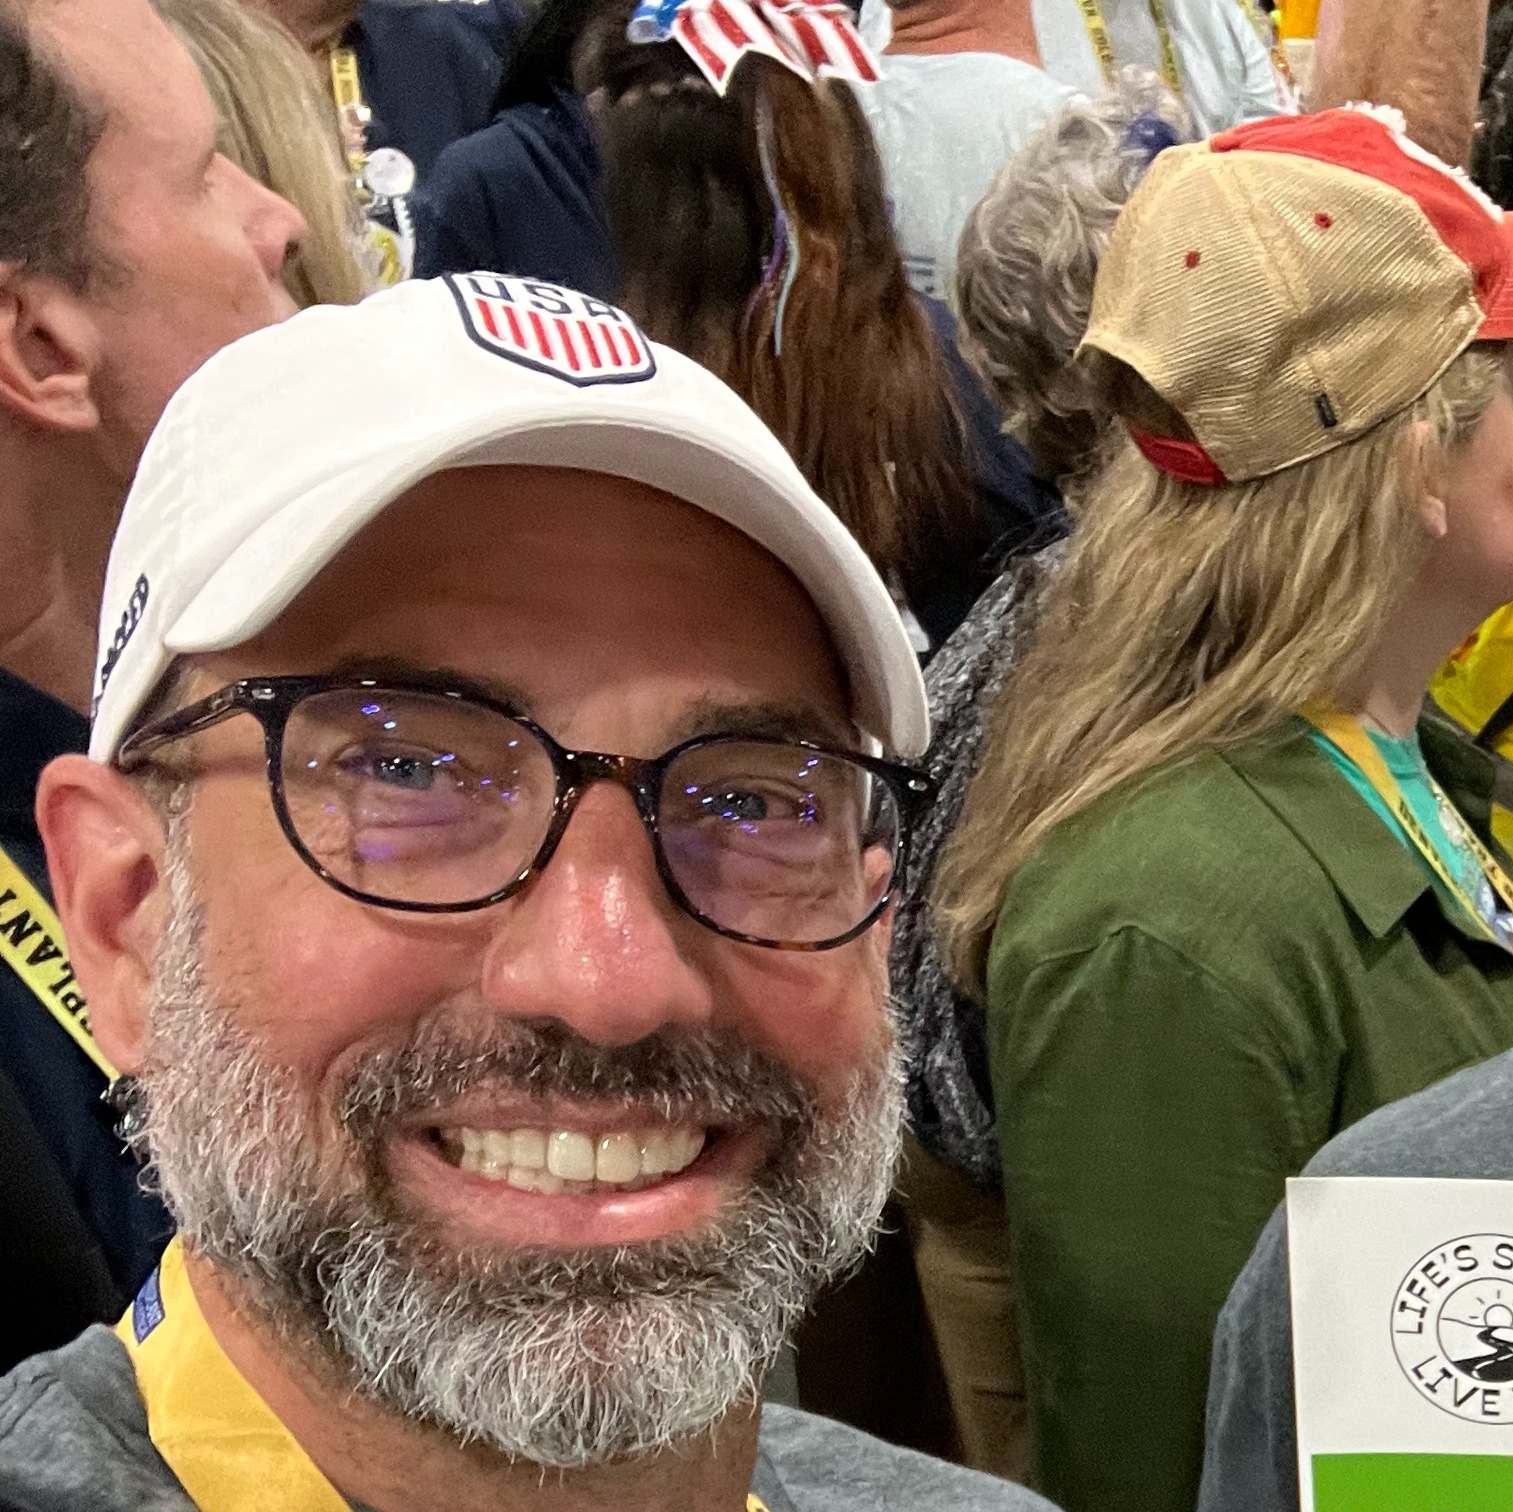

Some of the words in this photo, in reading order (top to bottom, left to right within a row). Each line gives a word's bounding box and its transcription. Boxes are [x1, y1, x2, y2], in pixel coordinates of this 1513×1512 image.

[467, 277, 622, 322] USA
[1396, 1244, 1478, 1337] LIFE'S
[1411, 1353, 1502, 1417] LIVE
